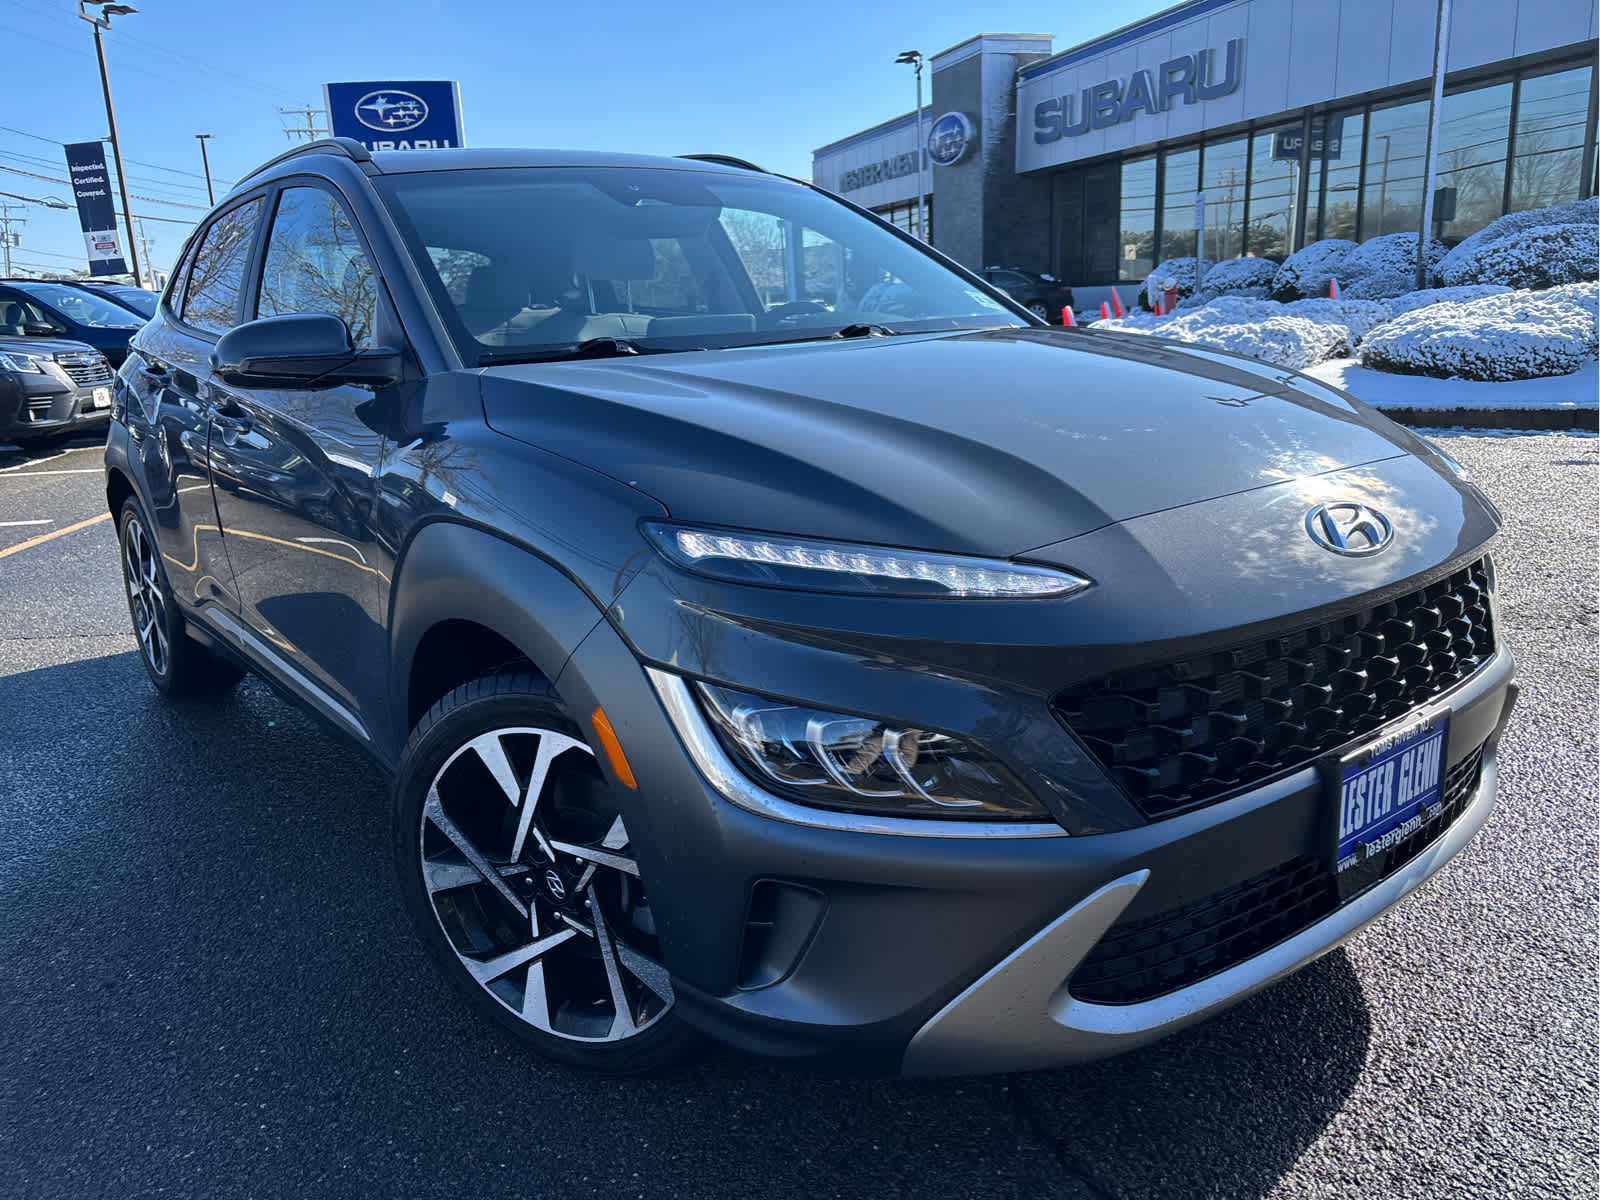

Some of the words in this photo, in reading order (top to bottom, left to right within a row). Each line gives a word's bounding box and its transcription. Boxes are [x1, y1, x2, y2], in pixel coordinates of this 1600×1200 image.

[1034, 38, 1244, 145] SUBARU
[71, 163, 105, 172] Inspected.
[840, 162, 881, 193] LESTER
[73, 176, 104, 185] Certified.
[76, 188, 106, 198] Covered.
[1339, 761, 1395, 841] LESTER
[1397, 734, 1443, 806] GLENN
